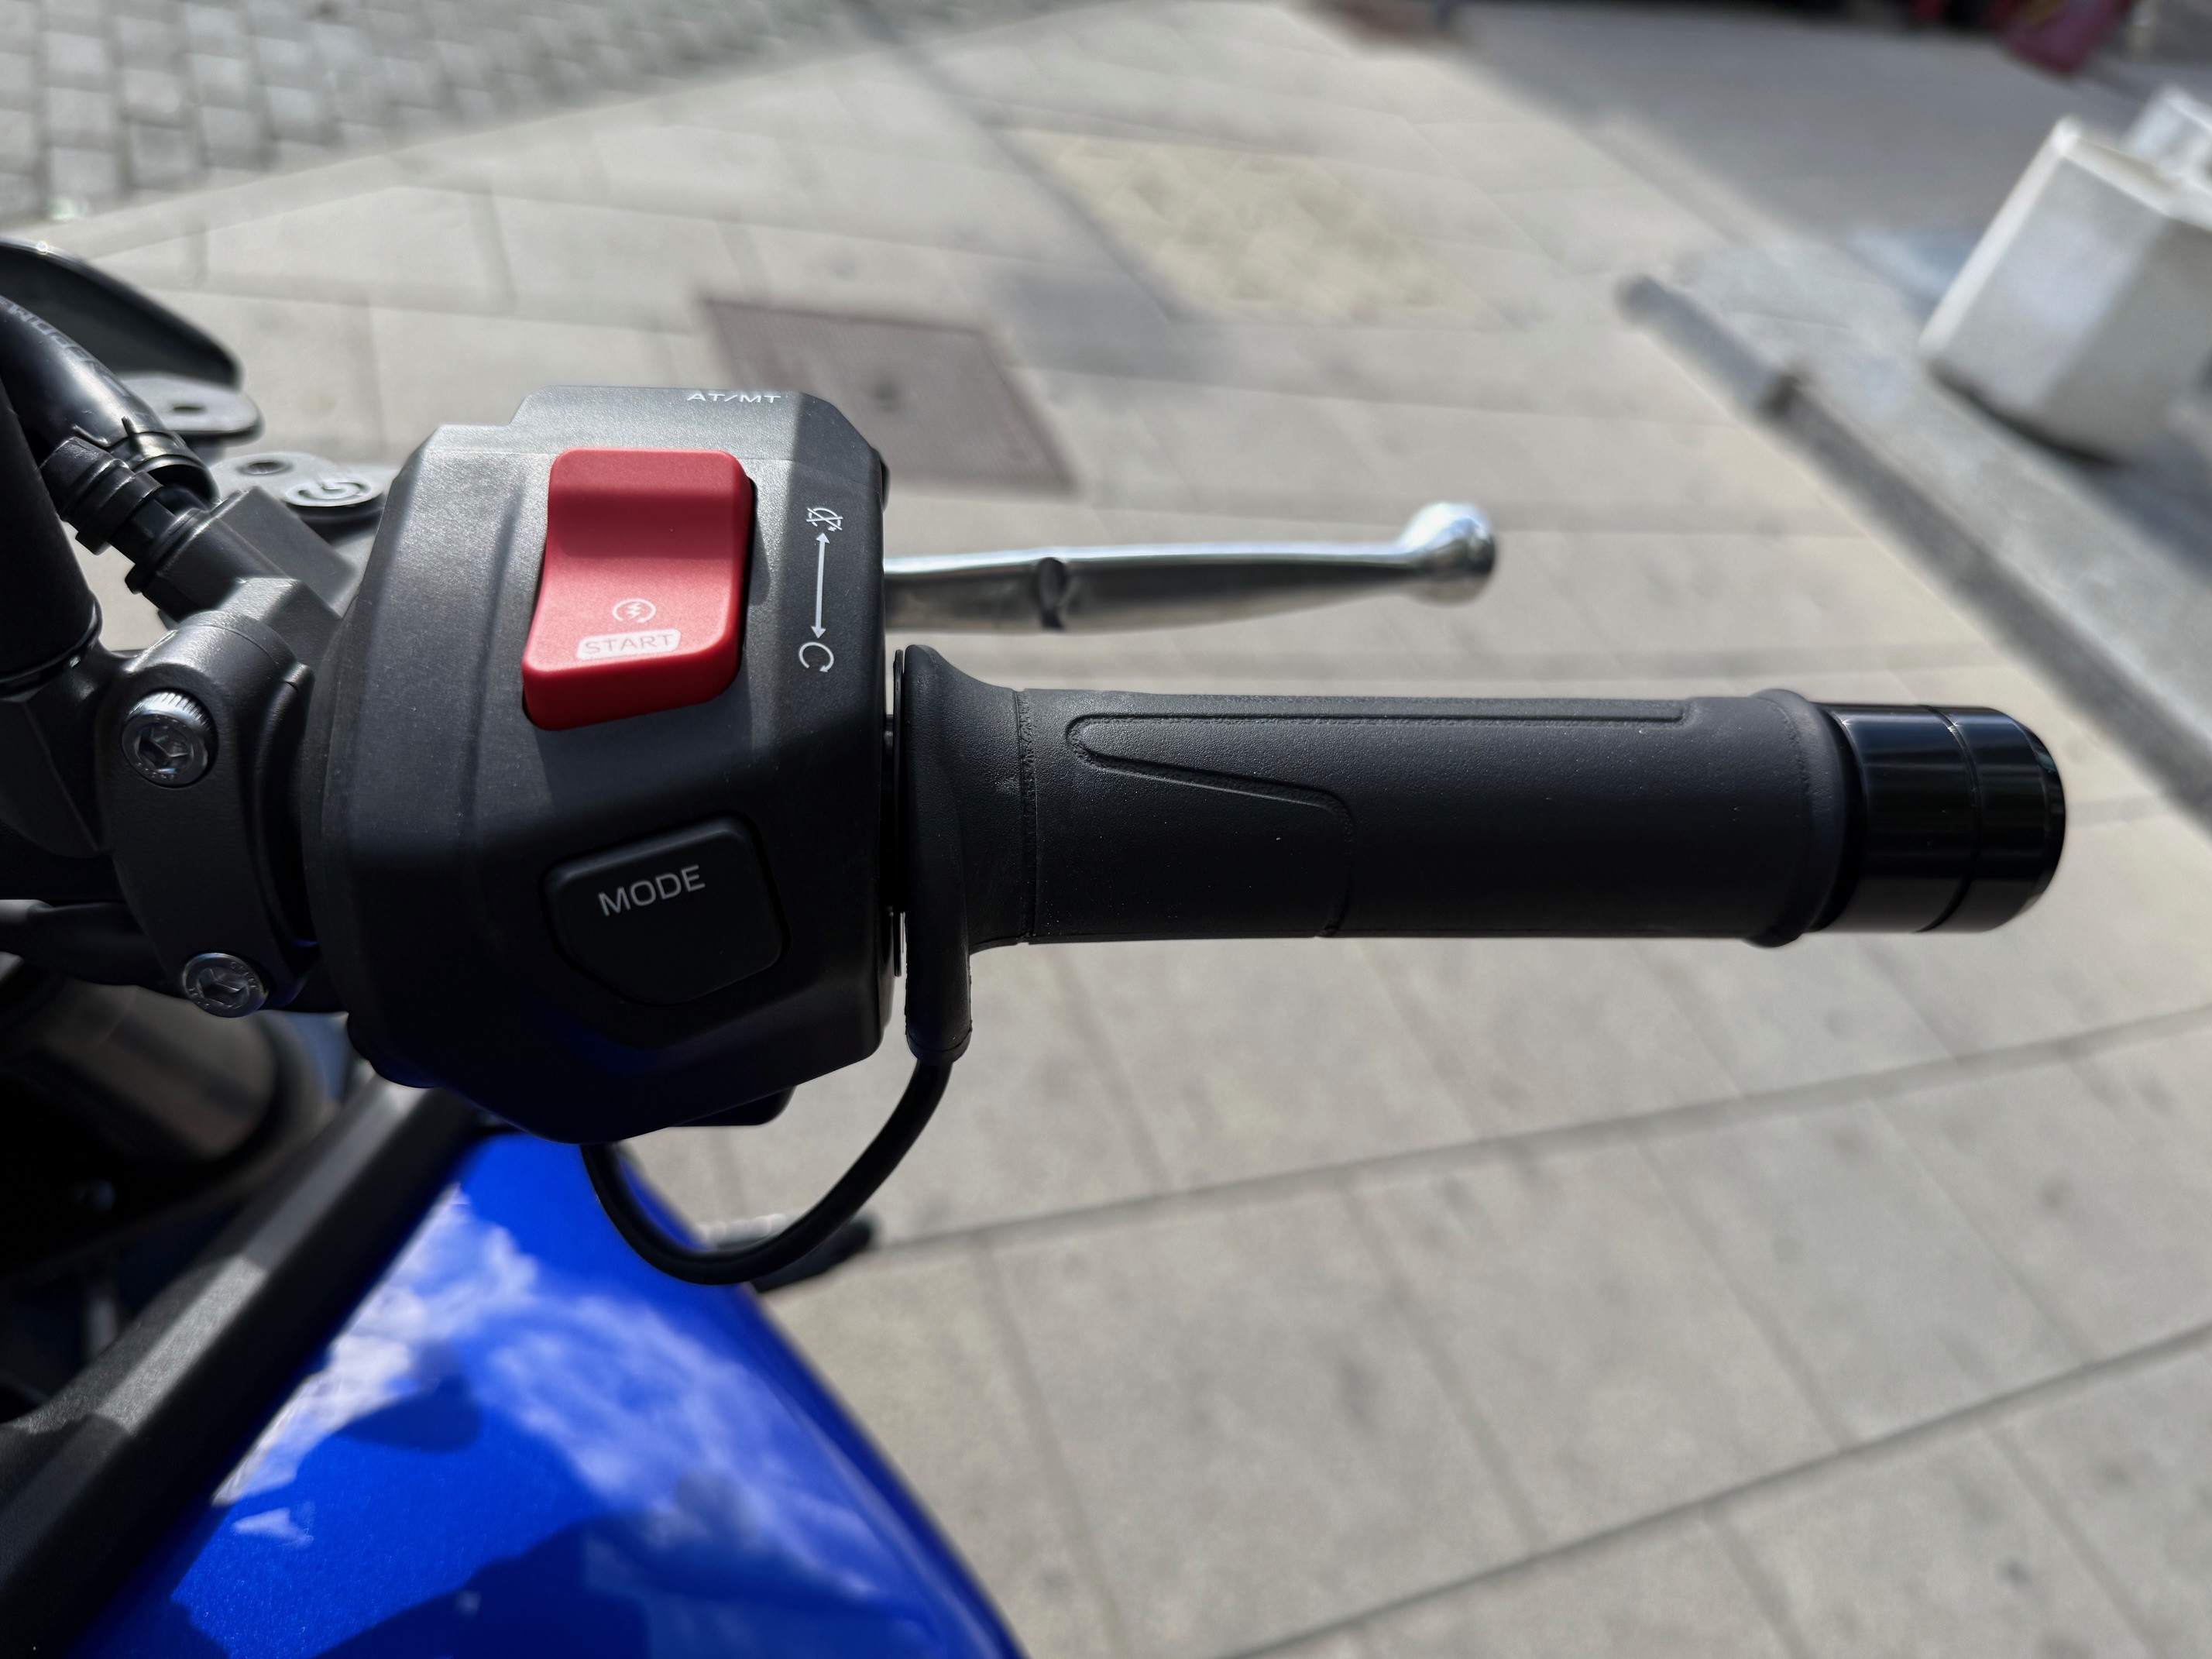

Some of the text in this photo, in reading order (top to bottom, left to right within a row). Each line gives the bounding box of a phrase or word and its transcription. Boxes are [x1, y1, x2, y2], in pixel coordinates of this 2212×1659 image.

[687, 393, 781, 404] AT/MT
[582, 634, 674, 654] START
[598, 864, 706, 916] MODE
